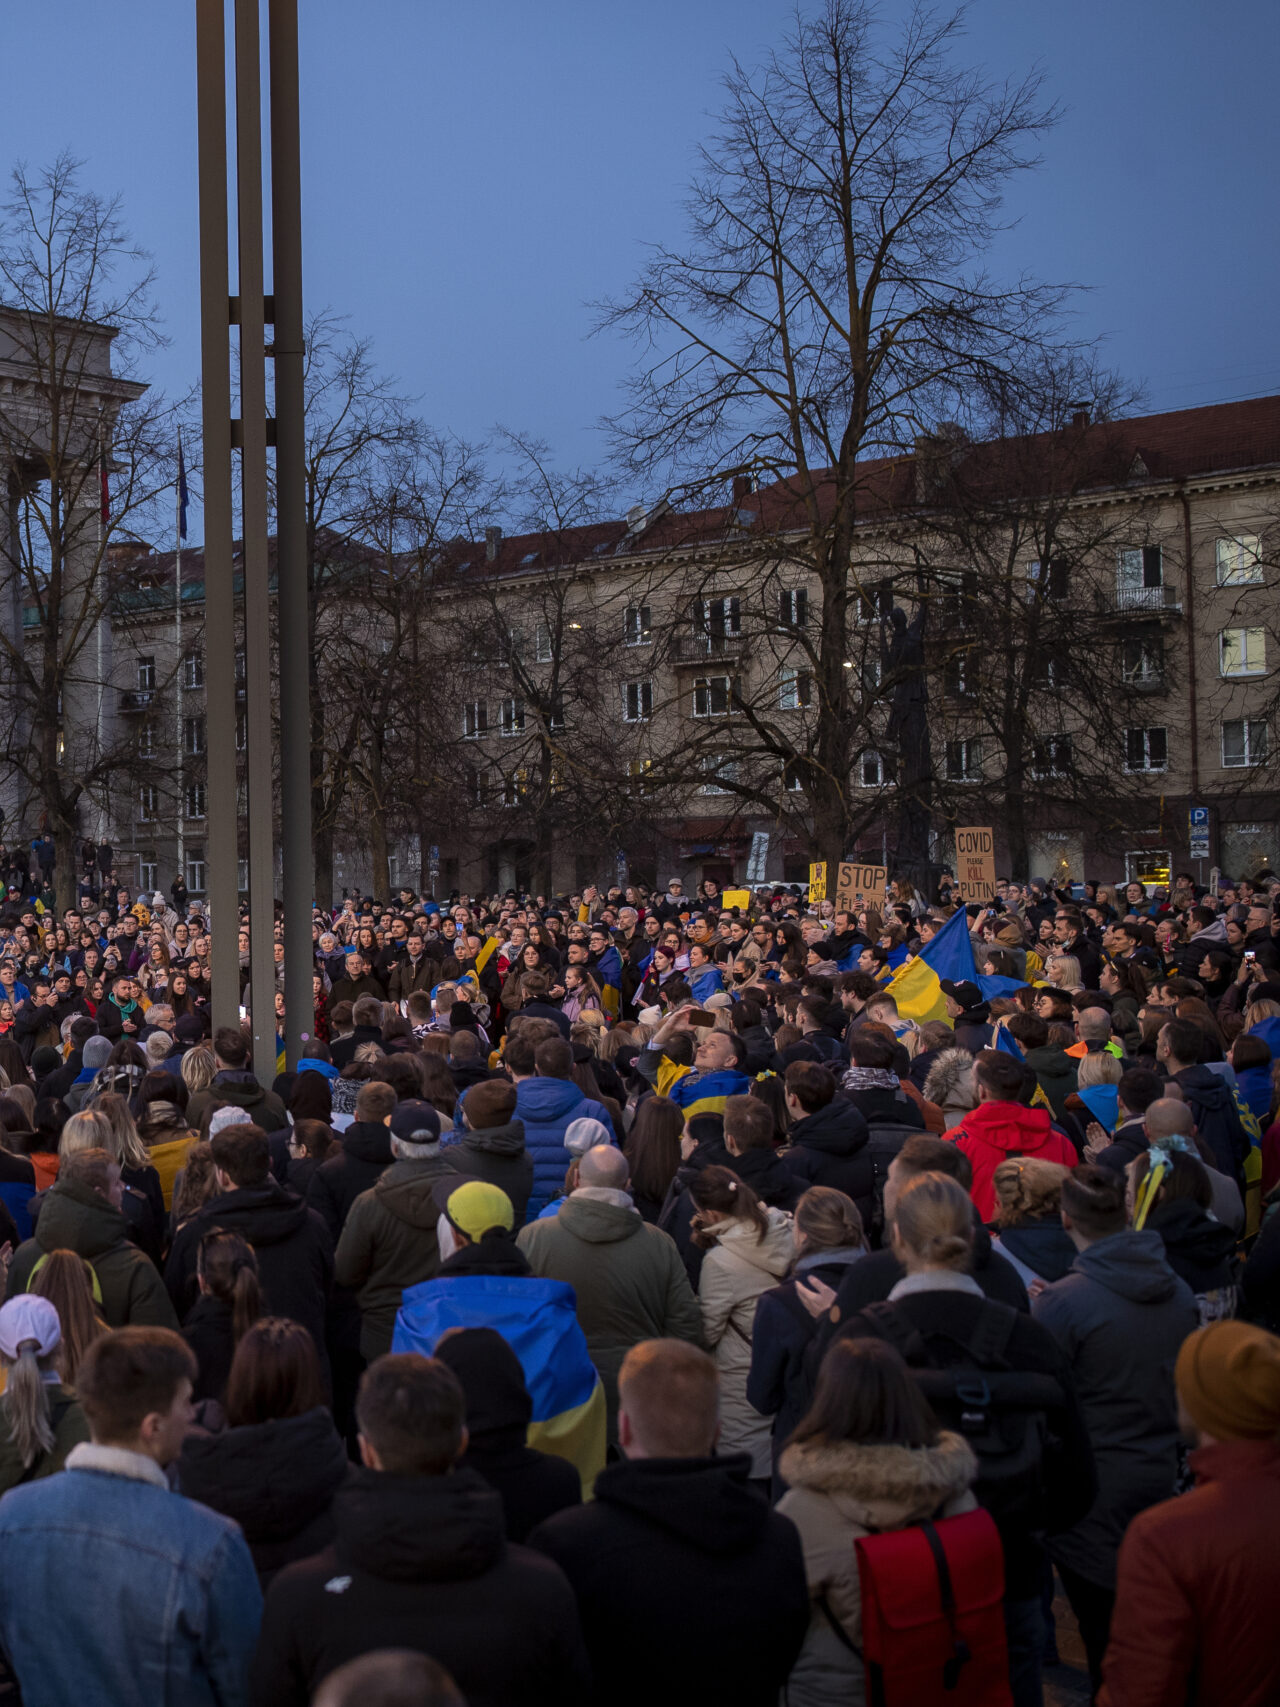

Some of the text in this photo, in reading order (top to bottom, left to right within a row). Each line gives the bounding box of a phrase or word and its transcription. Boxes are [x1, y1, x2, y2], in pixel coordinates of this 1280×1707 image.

[1194, 810, 1205, 823] P
[958, 832, 992, 853] COVID
[840, 866, 885, 889] STOP
[968, 867, 984, 880] KILL
[961, 882, 995, 898] PUTIN
